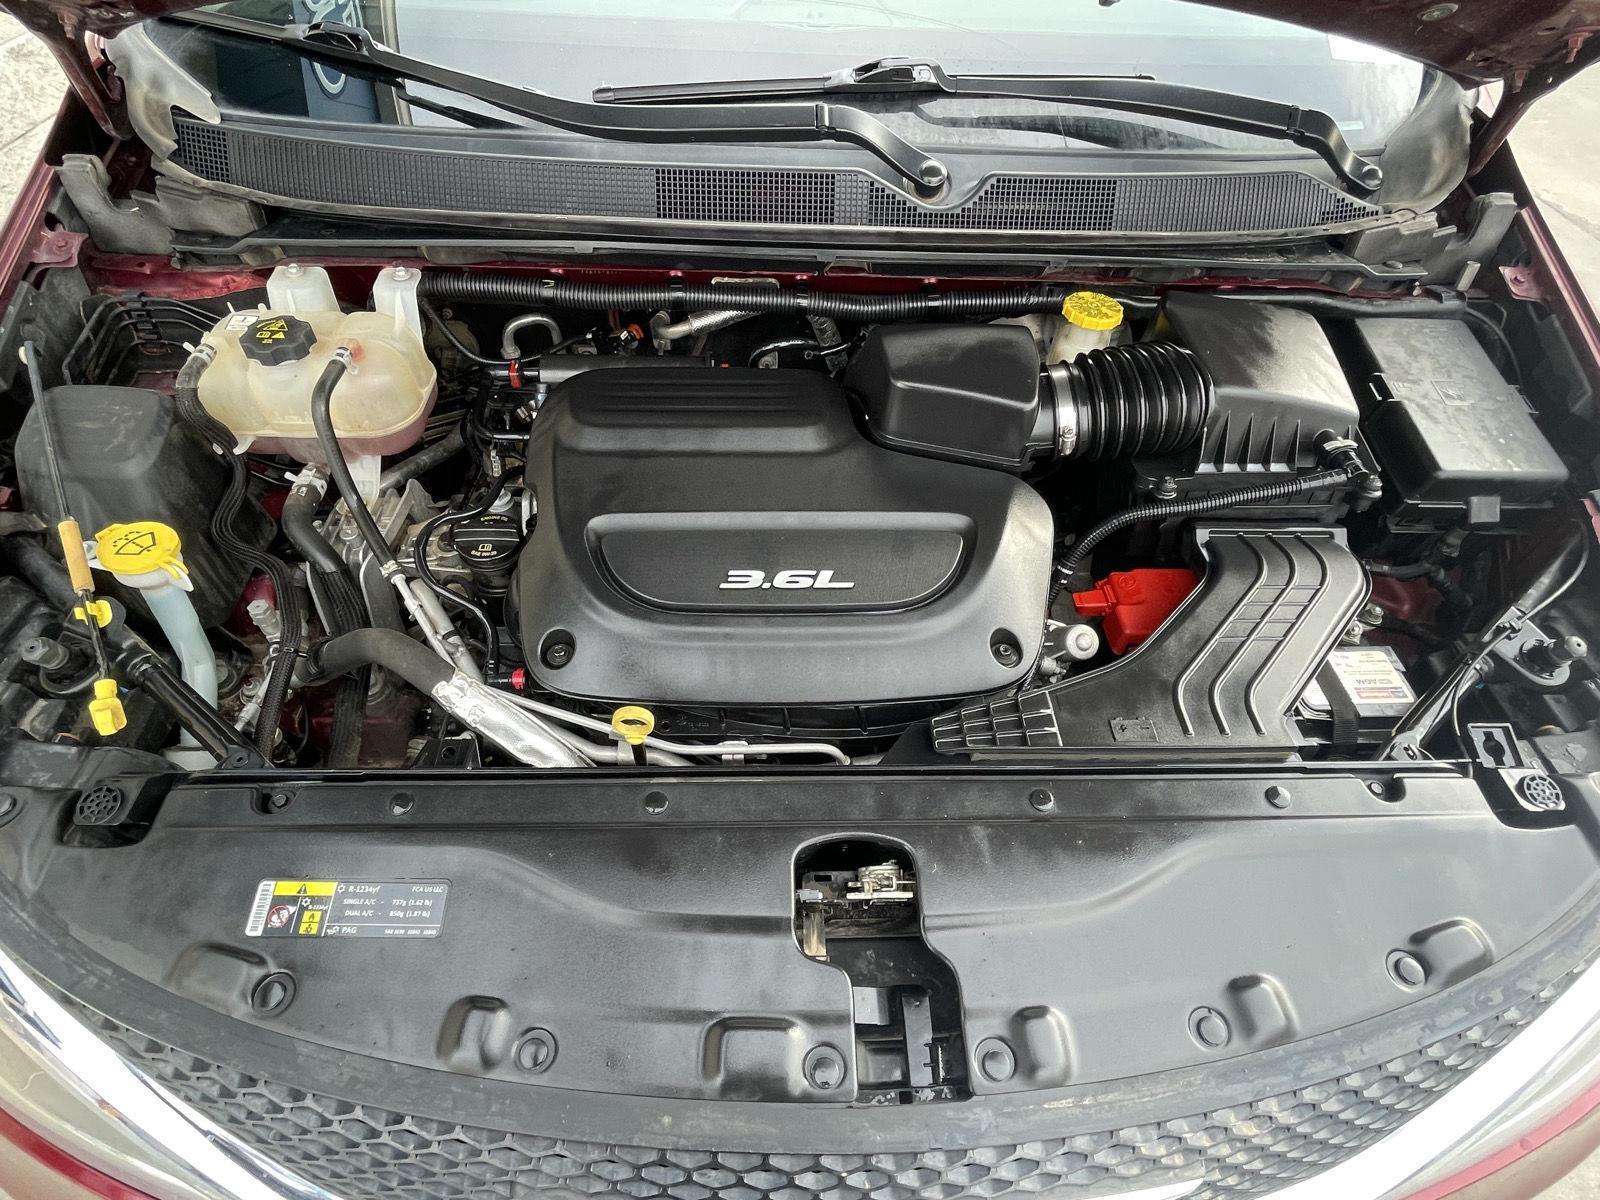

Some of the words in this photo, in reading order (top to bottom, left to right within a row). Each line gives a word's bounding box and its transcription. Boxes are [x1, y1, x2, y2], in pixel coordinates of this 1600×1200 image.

[719, 570, 855, 589] 3.6L
[348, 885, 381, 894] R-1234yf
[392, 899, 406, 907] 737g
[424, 899, 433, 907] lb)
[421, 910, 431, 918] lb)
[341, 926, 357, 934] PAG
